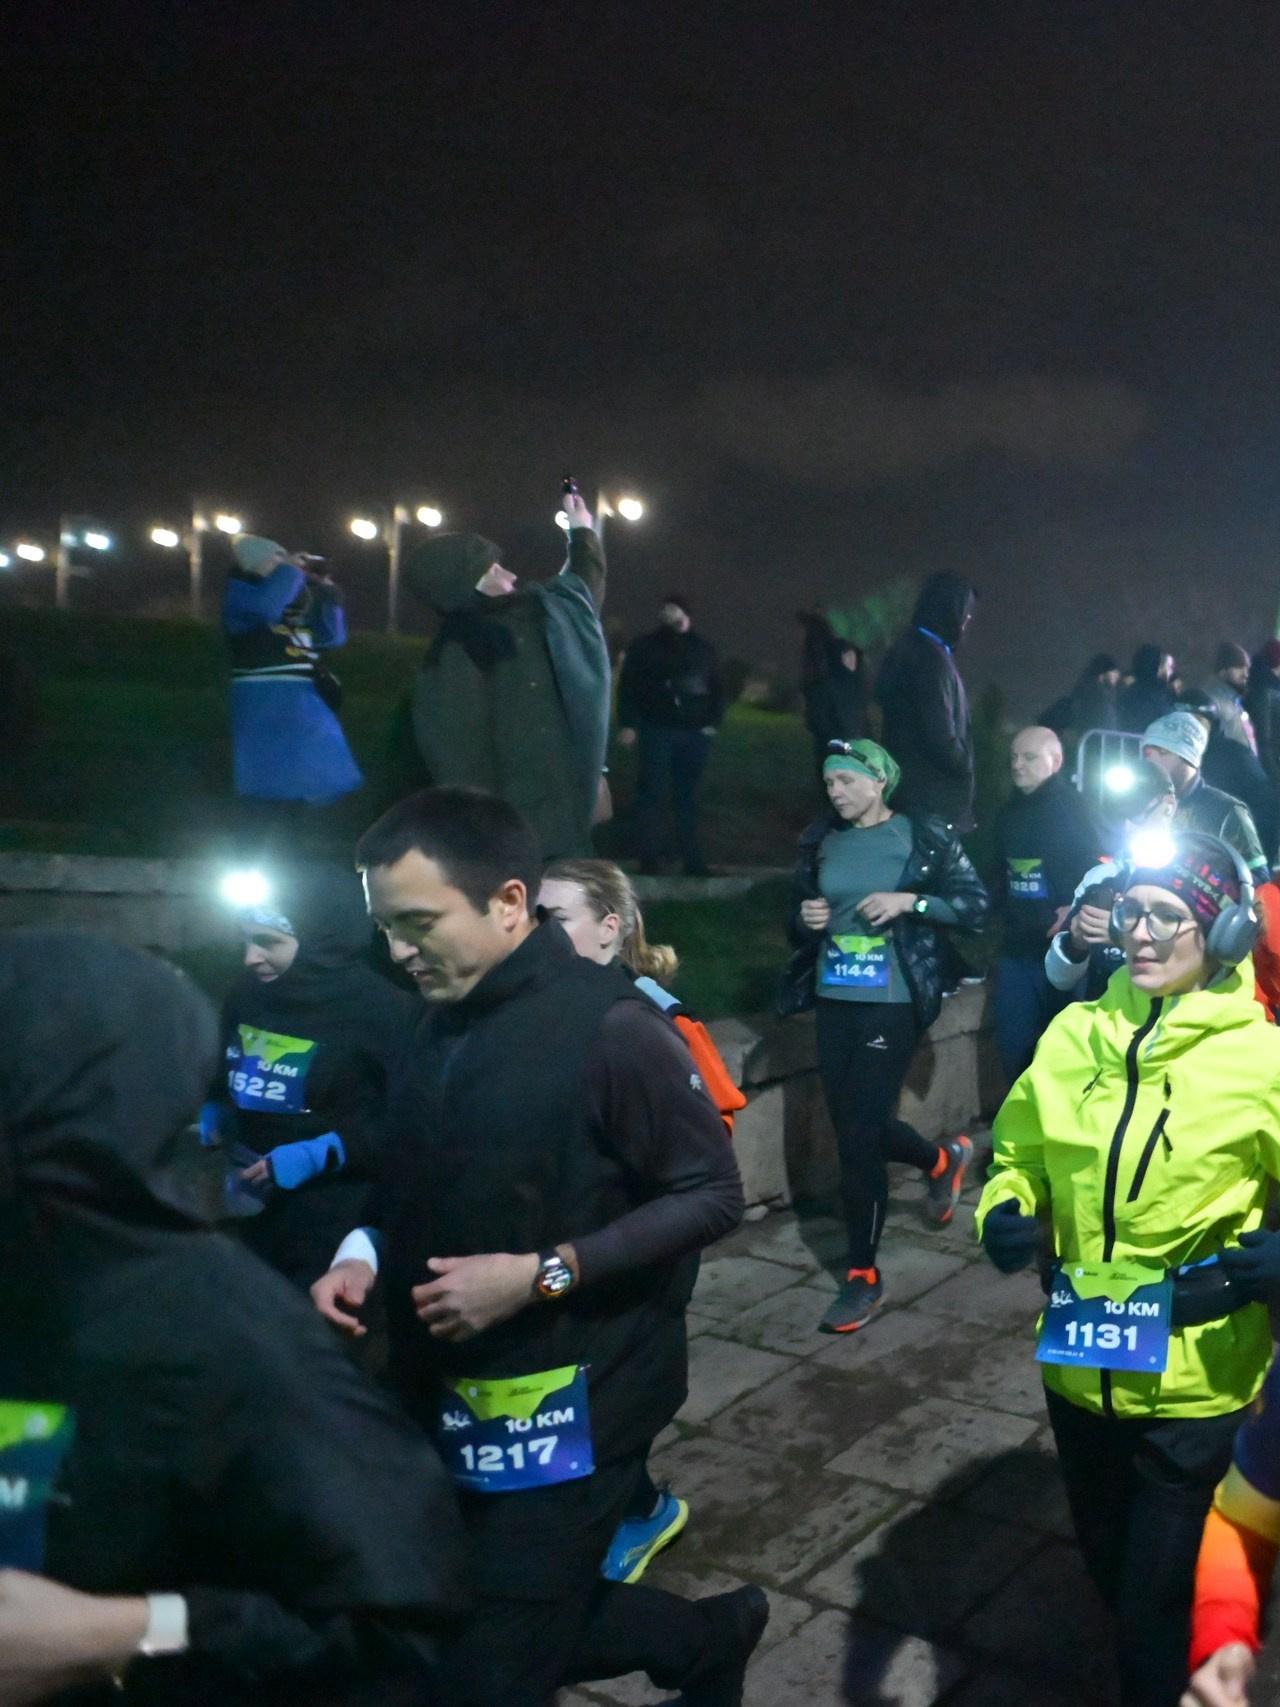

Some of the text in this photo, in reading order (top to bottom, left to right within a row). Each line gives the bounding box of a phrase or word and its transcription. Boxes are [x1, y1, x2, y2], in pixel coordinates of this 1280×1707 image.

[867, 954, 884, 962] KM
[834, 963, 877, 978] 1144
[273, 1063, 299, 1078] KM
[228, 1070, 287, 1101] 1522
[1104, 1300, 1160, 1317] 10 KM
[1065, 1321, 1138, 1351] 1131
[505, 1407, 575, 1434] 10 KM
[460, 1435, 559, 1471] 1217
